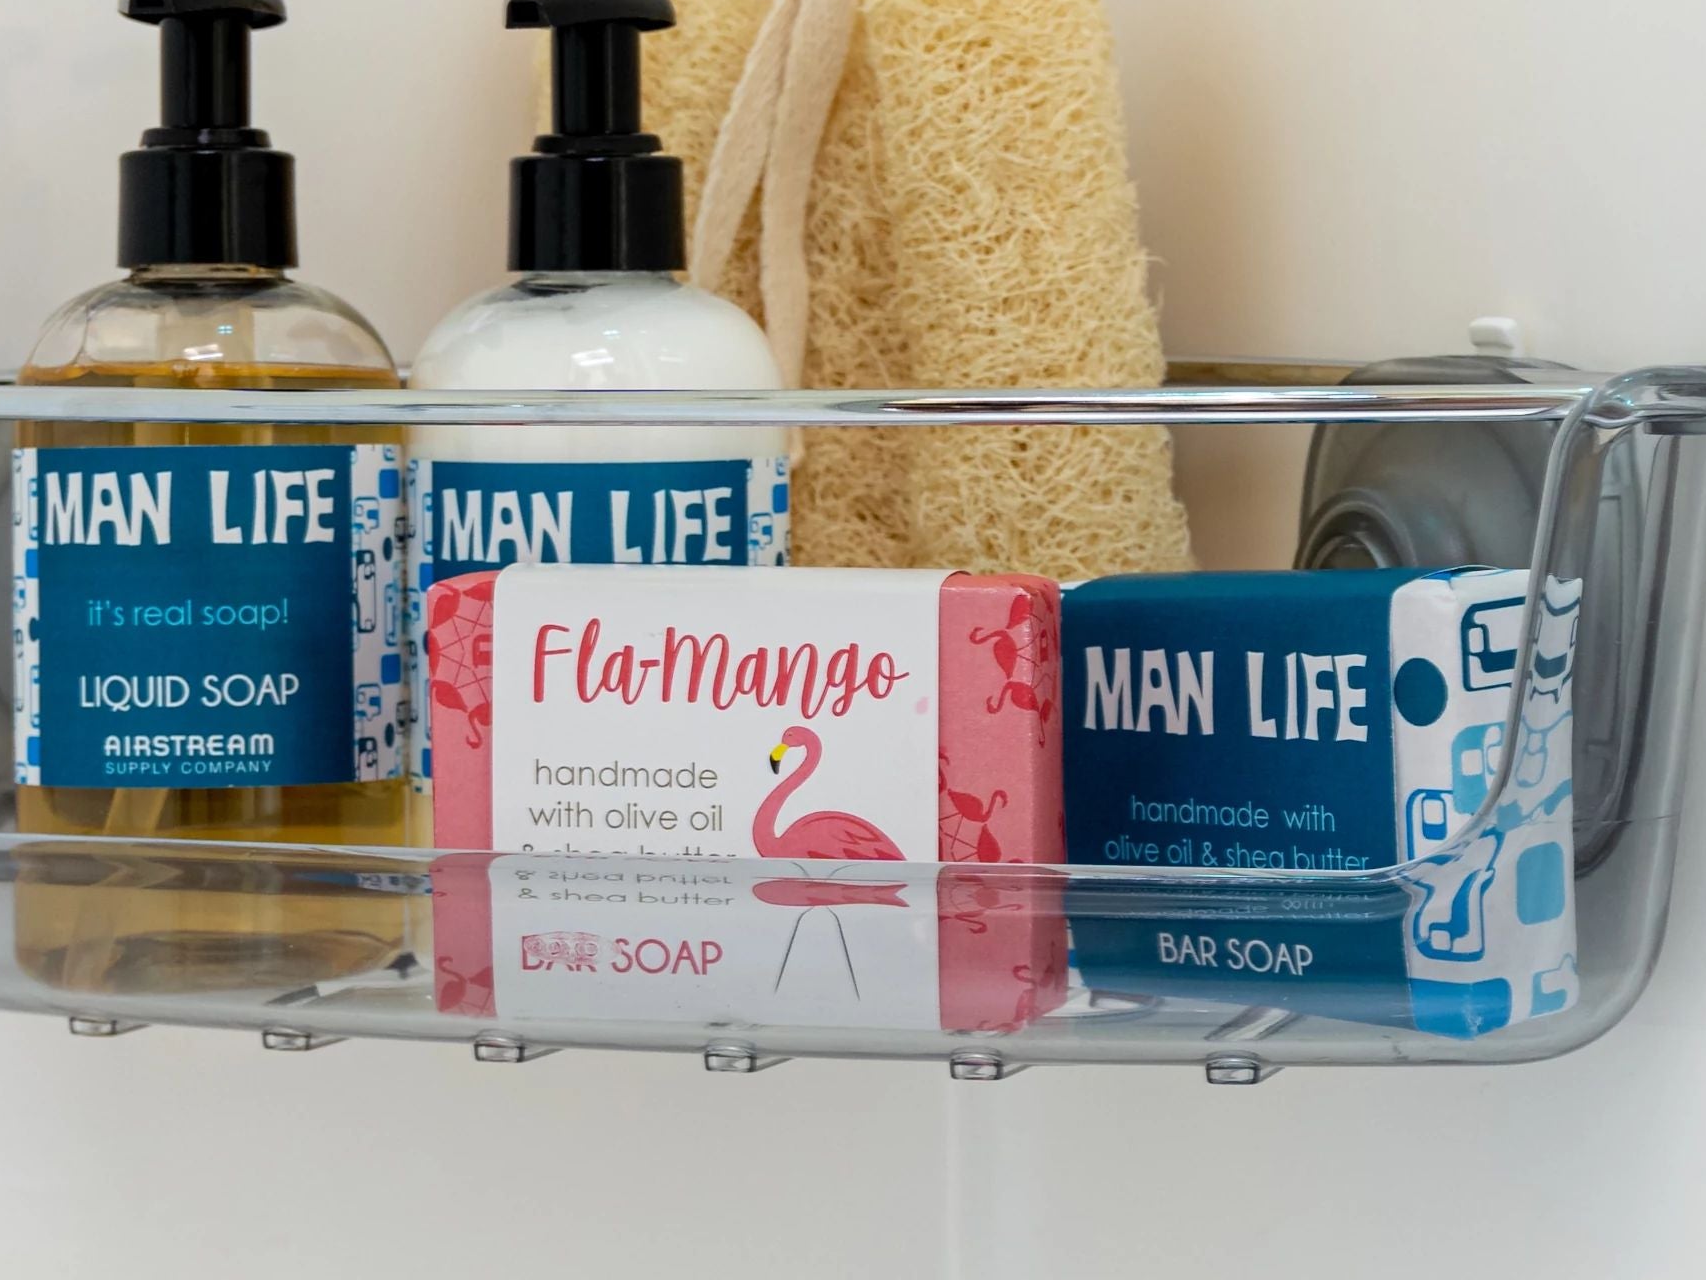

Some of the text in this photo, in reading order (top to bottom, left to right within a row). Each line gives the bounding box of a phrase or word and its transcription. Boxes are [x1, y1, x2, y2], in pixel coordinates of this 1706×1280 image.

[44, 469, 335, 546] MAN LIFE
[440, 486, 733, 564] MAN LIFE
[87, 597, 289, 631] it's real soap!
[532, 617, 910, 720] Fla-Mango
[79, 673, 300, 712] LIQUID SOAP
[1083, 646, 1369, 742] MAN LIFE
[104, 733, 275, 756] AIRSTREAM
[105, 760, 272, 775] SUPPLY COMPANY
[533, 758, 719, 789] handmade
[528, 800, 724, 832] with olive oil
[1130, 795, 1336, 833] handmade with
[1104, 834, 1370, 872] olive oil & shea butter
[549, 888, 628, 903] shea
[638, 890, 736, 907] butter
[610, 936, 724, 976] SOAP
[1158, 932, 1314, 976] BAR SOAP
